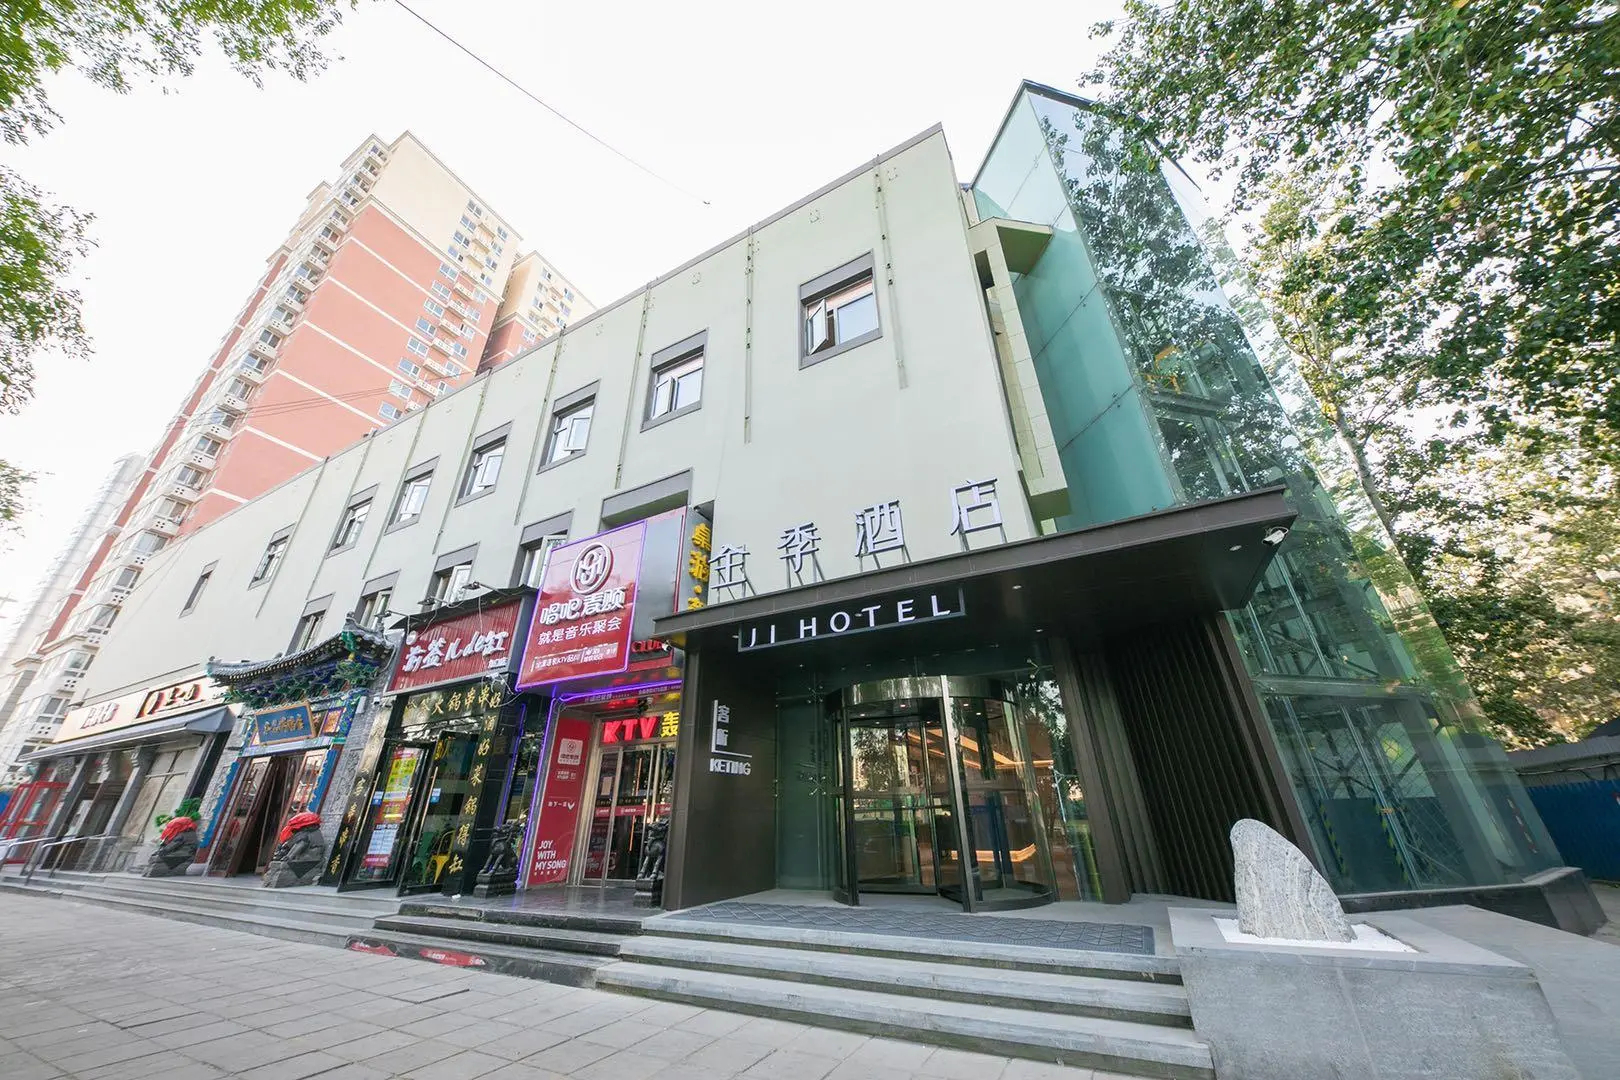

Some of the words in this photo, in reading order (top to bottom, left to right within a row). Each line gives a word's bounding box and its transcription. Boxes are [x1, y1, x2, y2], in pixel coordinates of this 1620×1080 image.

[708, 478, 1002, 590] 全季酒店
[538, 617, 622, 645] 就是音乐聚会
[750, 625, 776, 648] JI
[800, 594, 951, 640] HOTEL
[602, 716, 660, 744] KTV
[709, 758, 751, 776] KETING
[536, 850, 557, 860] WITH
[538, 839, 554, 850] JOY
[534, 861, 547, 871] MY
[547, 859, 567, 870] SONG
